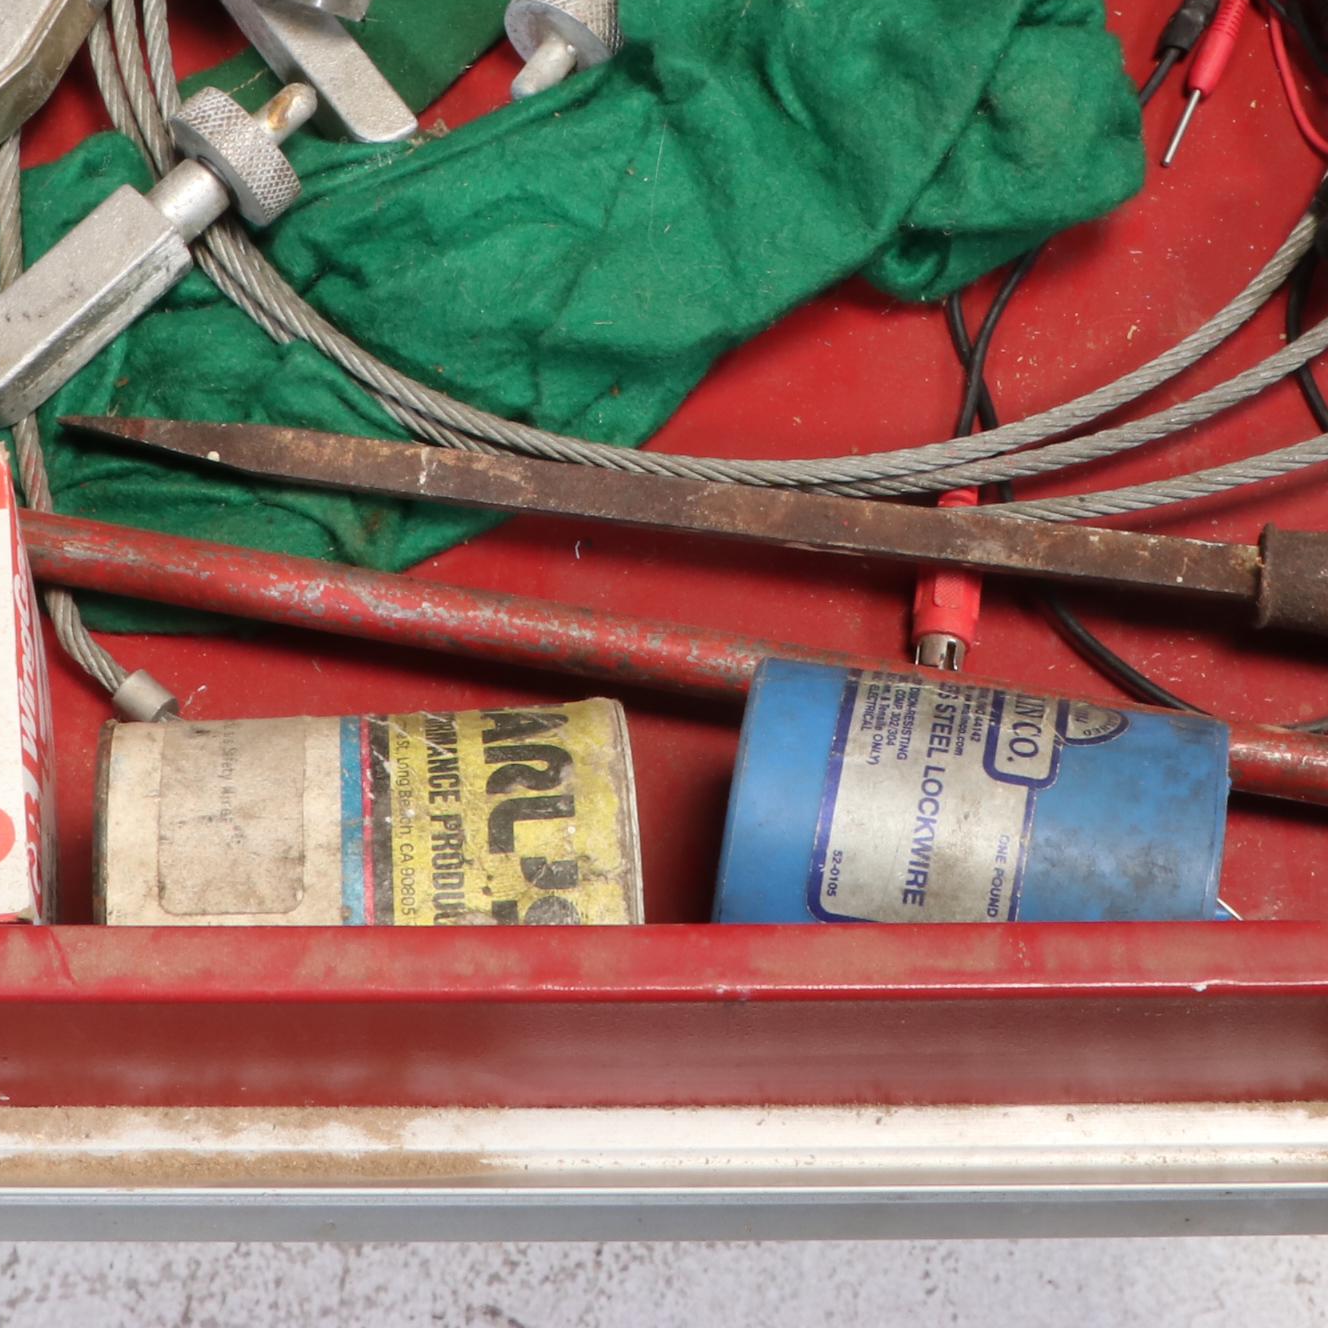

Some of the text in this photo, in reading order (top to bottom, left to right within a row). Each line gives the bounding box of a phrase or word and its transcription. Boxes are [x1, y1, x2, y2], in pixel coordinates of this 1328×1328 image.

[926, 703, 957, 758] STEEL
[400, 842, 415, 863] CA
[902, 765, 946, 907] LOCKWIRE
[400, 867, 416, 916] 90805
[827, 849, 843, 897] 52-0105
[986, 834, 1010, 918] ONE POUND
